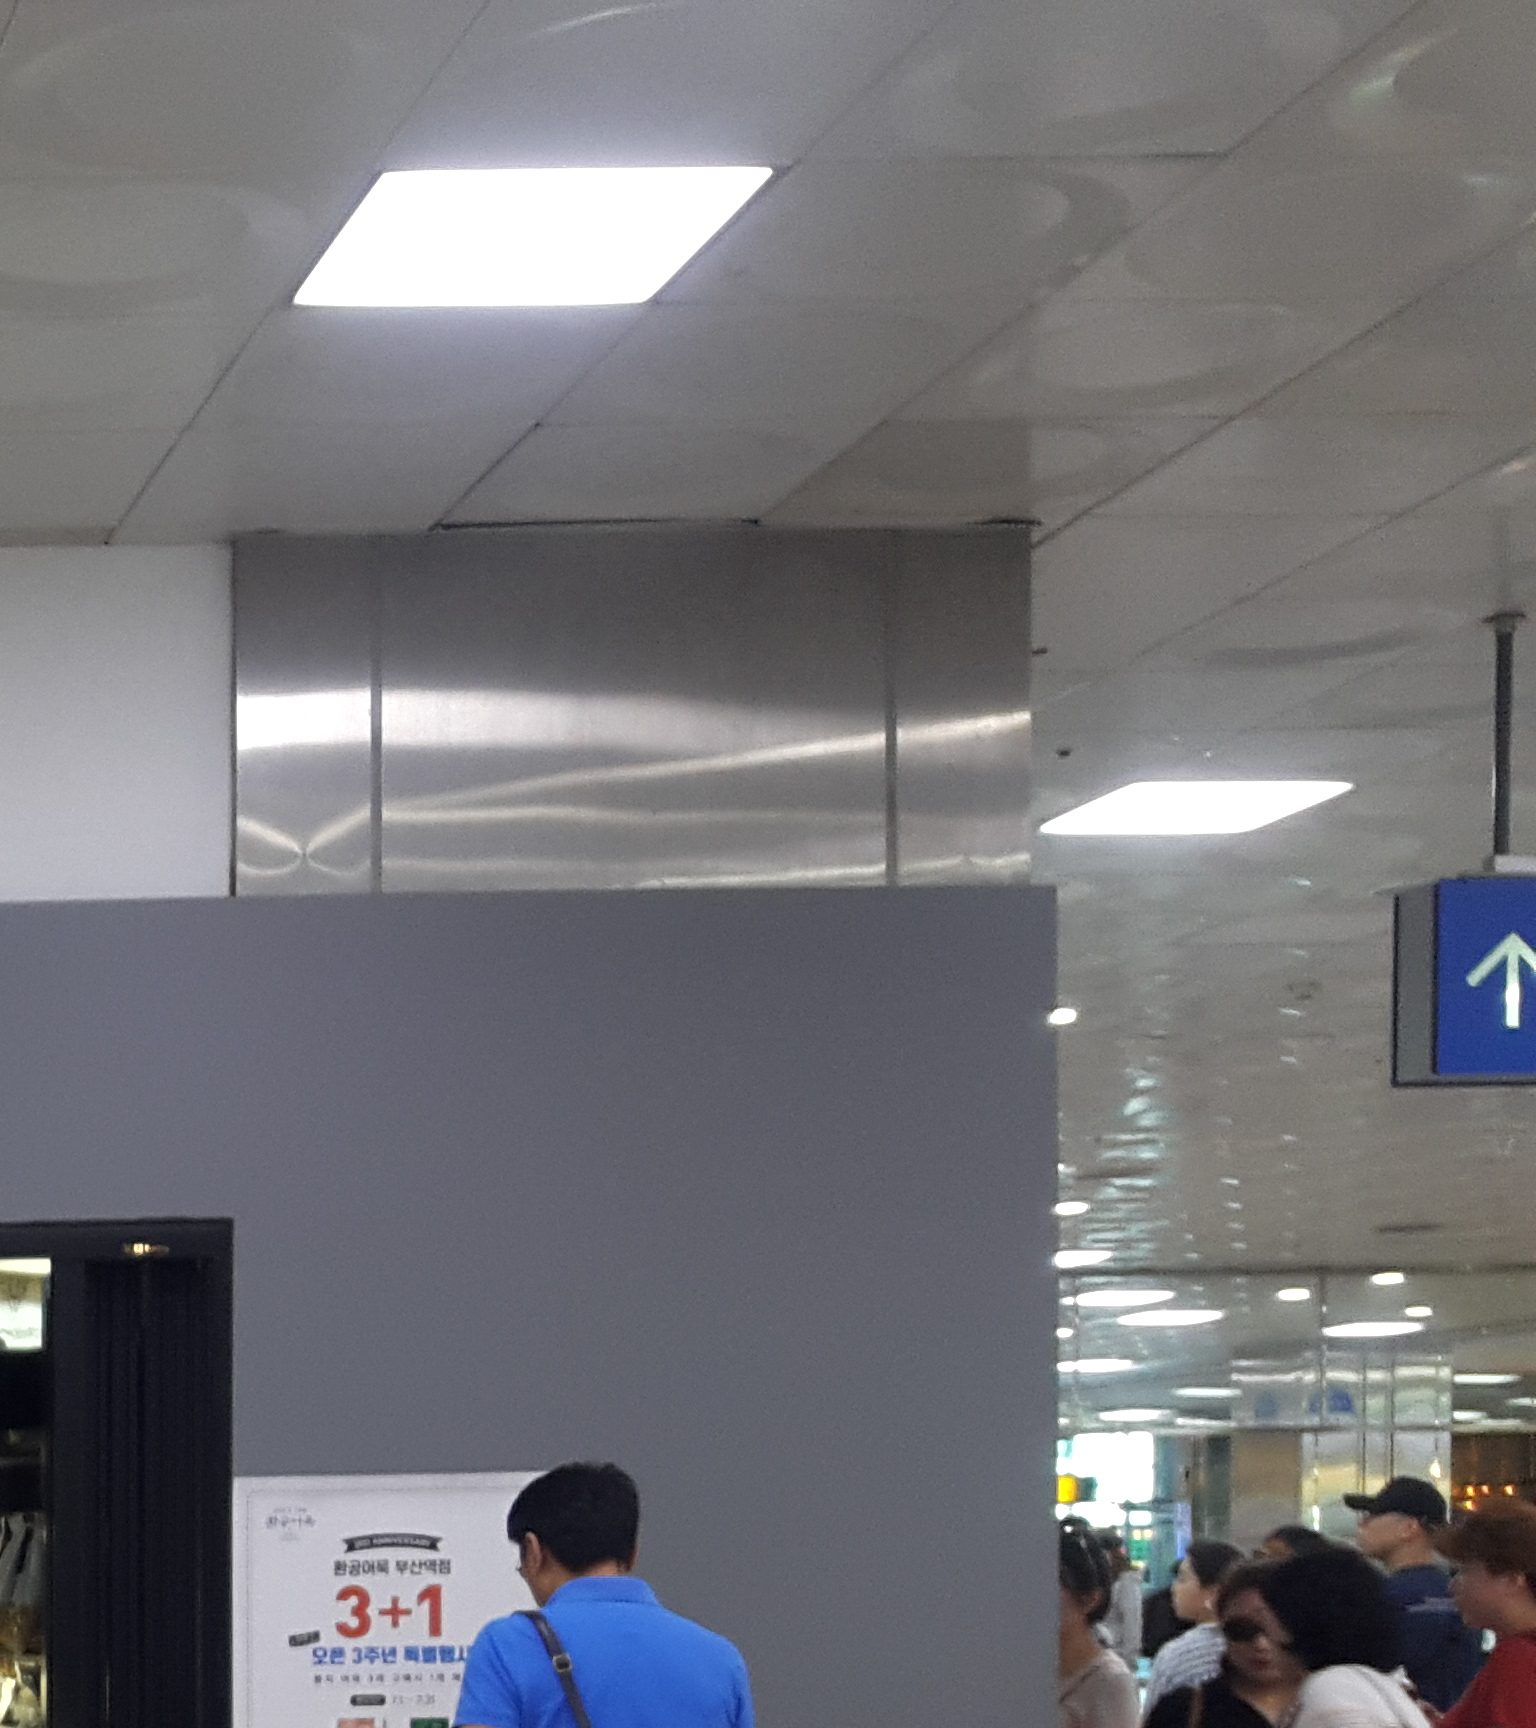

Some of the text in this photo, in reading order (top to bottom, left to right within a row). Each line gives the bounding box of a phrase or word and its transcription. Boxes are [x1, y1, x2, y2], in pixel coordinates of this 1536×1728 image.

[333, 1557, 453, 1577] 환공어묵 부산역점
[335, 1583, 442, 1639] 3+1
[312, 1647, 347, 1666] 오픈
[351, 1646, 398, 1665] 3주년
